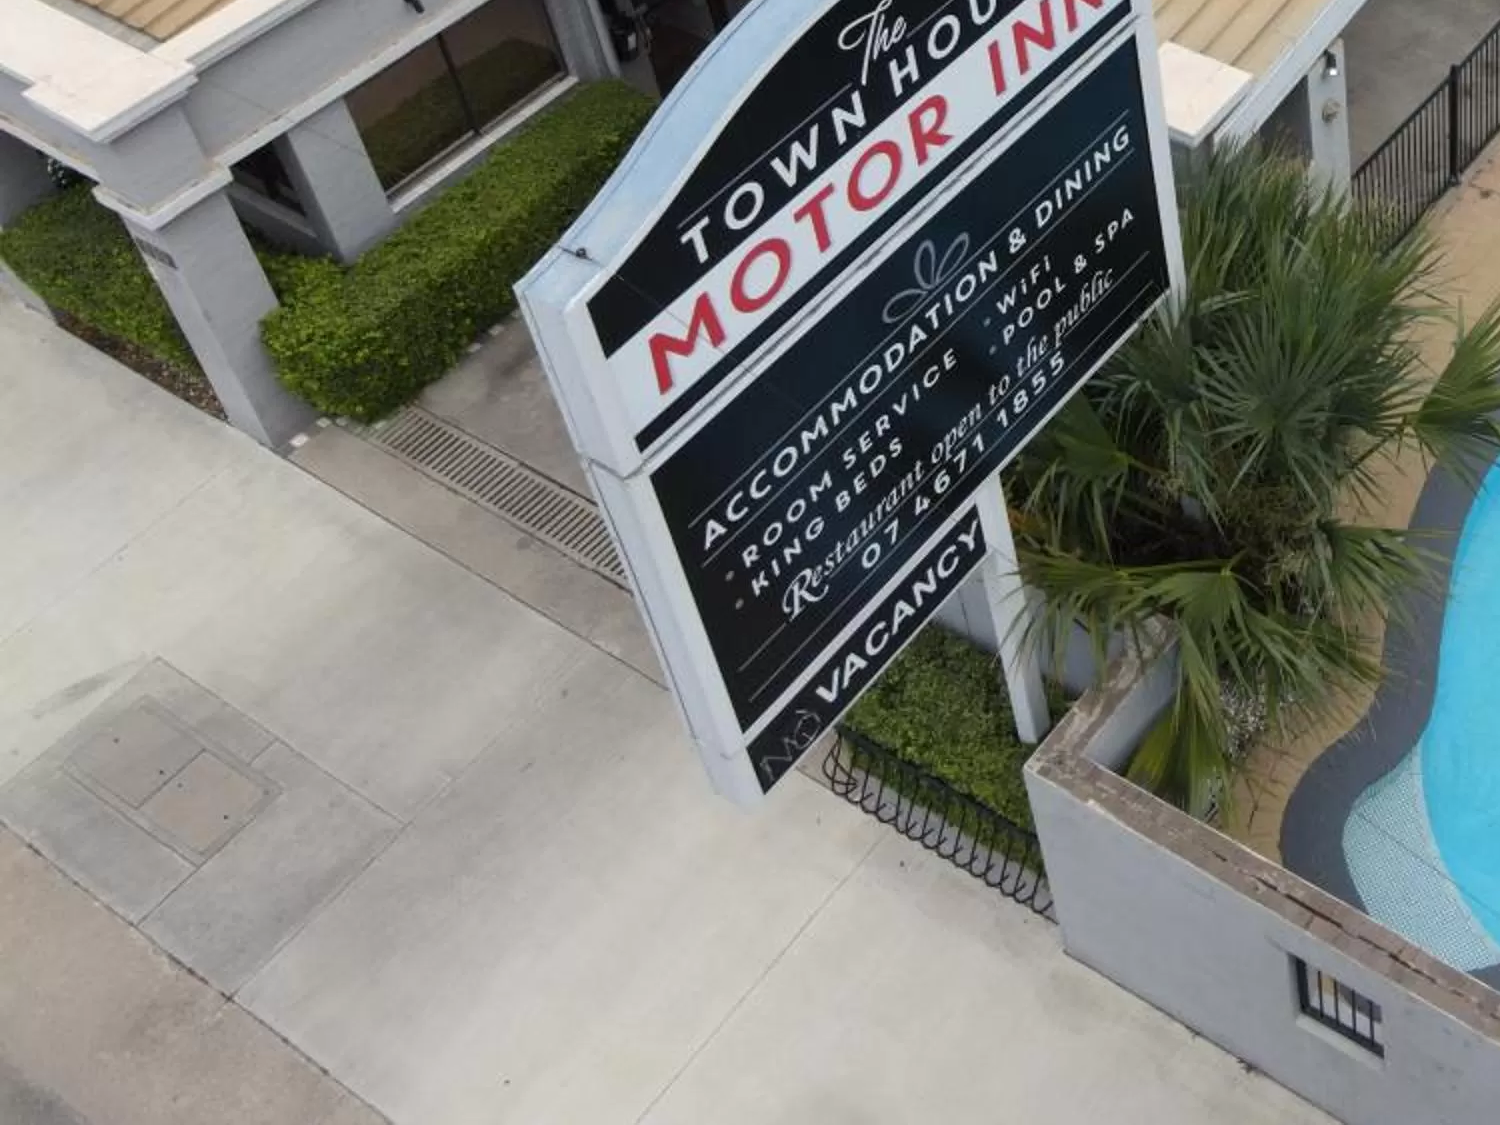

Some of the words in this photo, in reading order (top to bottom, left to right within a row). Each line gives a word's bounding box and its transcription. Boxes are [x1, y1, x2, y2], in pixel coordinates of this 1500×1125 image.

[648, 95, 953, 396] MOTOR
[680, 90, 868, 265] TOWN
[1002, 275, 1067, 346] POOL
[1073, 254, 1088, 275] &
[1095, 206, 1135, 256] SPA
[704, 251, 999, 551] ACCOMMODATION
[1008, 228, 1028, 255] &
[1034, 126, 1131, 229] DINING
[782, 458, 924, 623] Restaurant
[930, 403, 983, 467] open
[987, 374, 1011, 406] to
[1015, 332, 1050, 379] the
[1053, 266, 1115, 350] public
[742, 470, 834, 568] ROOM
[843, 348, 958, 470] SERVICE
[751, 516, 825, 597] KING
[835, 437, 903, 513] BEDS
[860, 518, 900, 570] 07
[914, 433, 986, 517] 4671
[996, 349, 1066, 429] 1855
[814, 518, 980, 705] VACANCY
